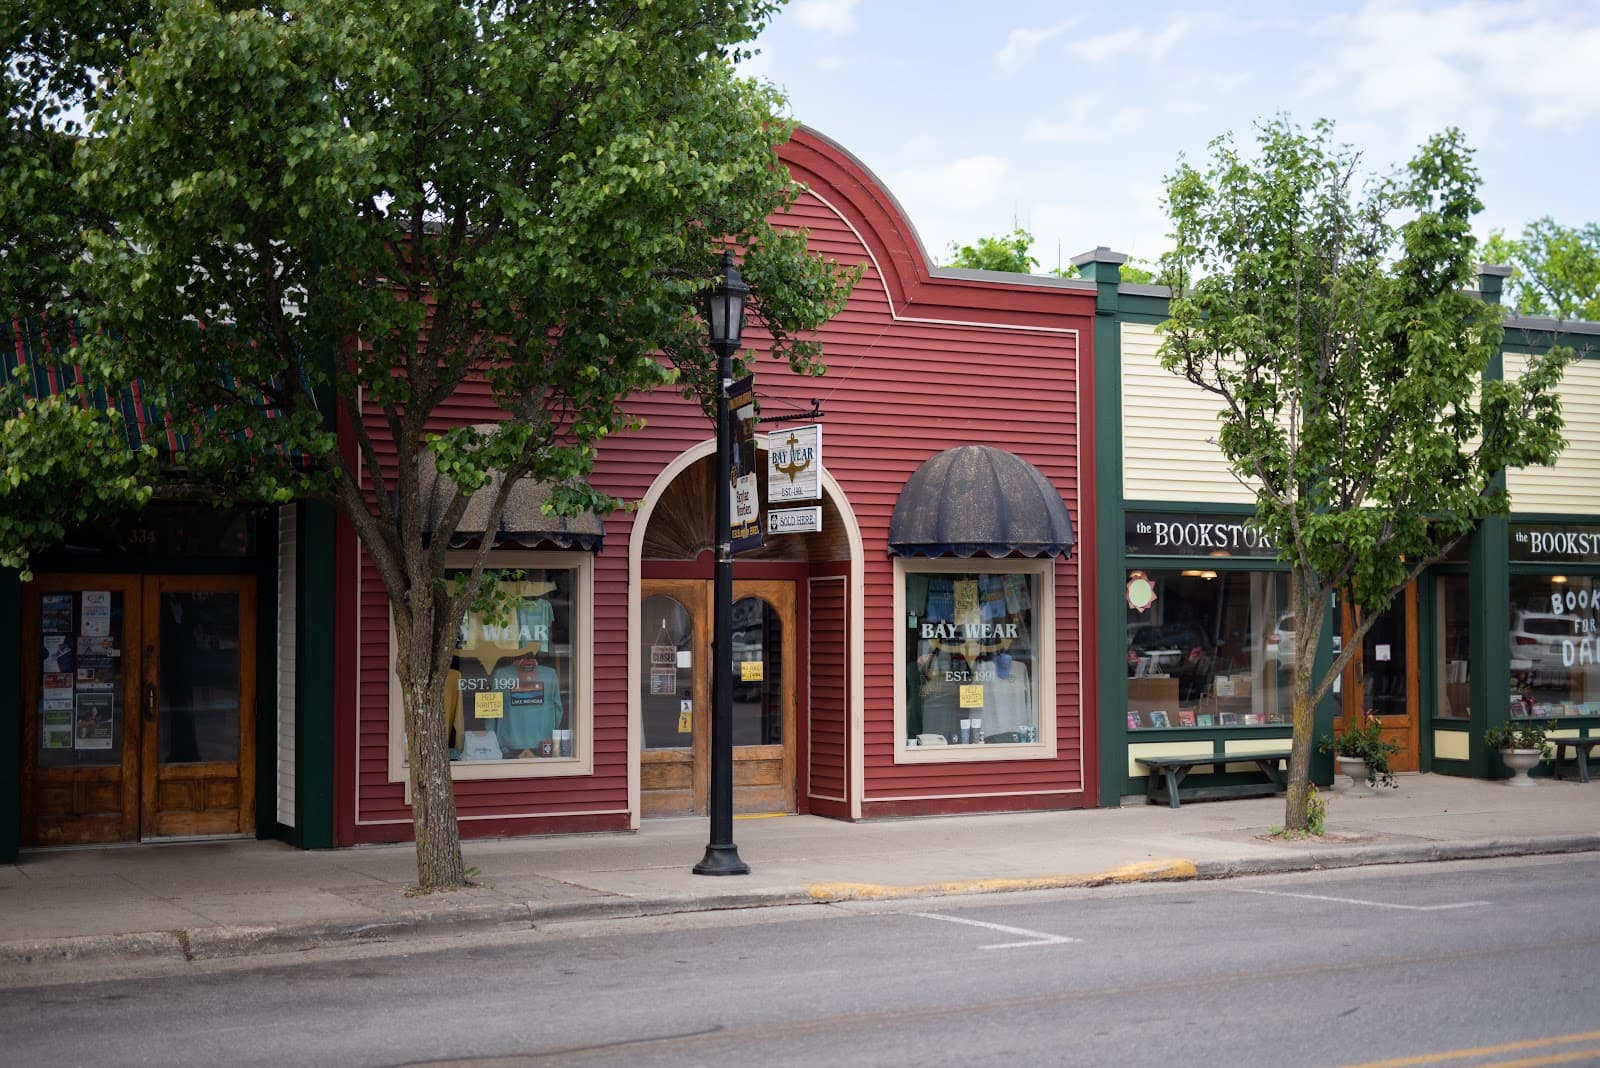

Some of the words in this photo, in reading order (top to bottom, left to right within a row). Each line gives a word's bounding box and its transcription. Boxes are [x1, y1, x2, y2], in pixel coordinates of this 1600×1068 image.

[772, 451, 787, 465] BAY
[789, 447, 814, 463] WEAR
[780, 516, 795, 527] SOLD
[1136, 522, 1152, 534] the
[129, 529, 156, 544] 334
[1515, 531, 1529, 543] the
[921, 623, 958, 638] BAY
[964, 623, 1018, 638] WEAR
[1574, 618, 1597, 633] FOR
[481, 624, 549, 641] WEAR
[652, 652, 674, 663] CLOSED
[944, 671, 972, 682] EST.
[456, 678, 490, 690] EST.
[494, 678, 520, 690] 1991
